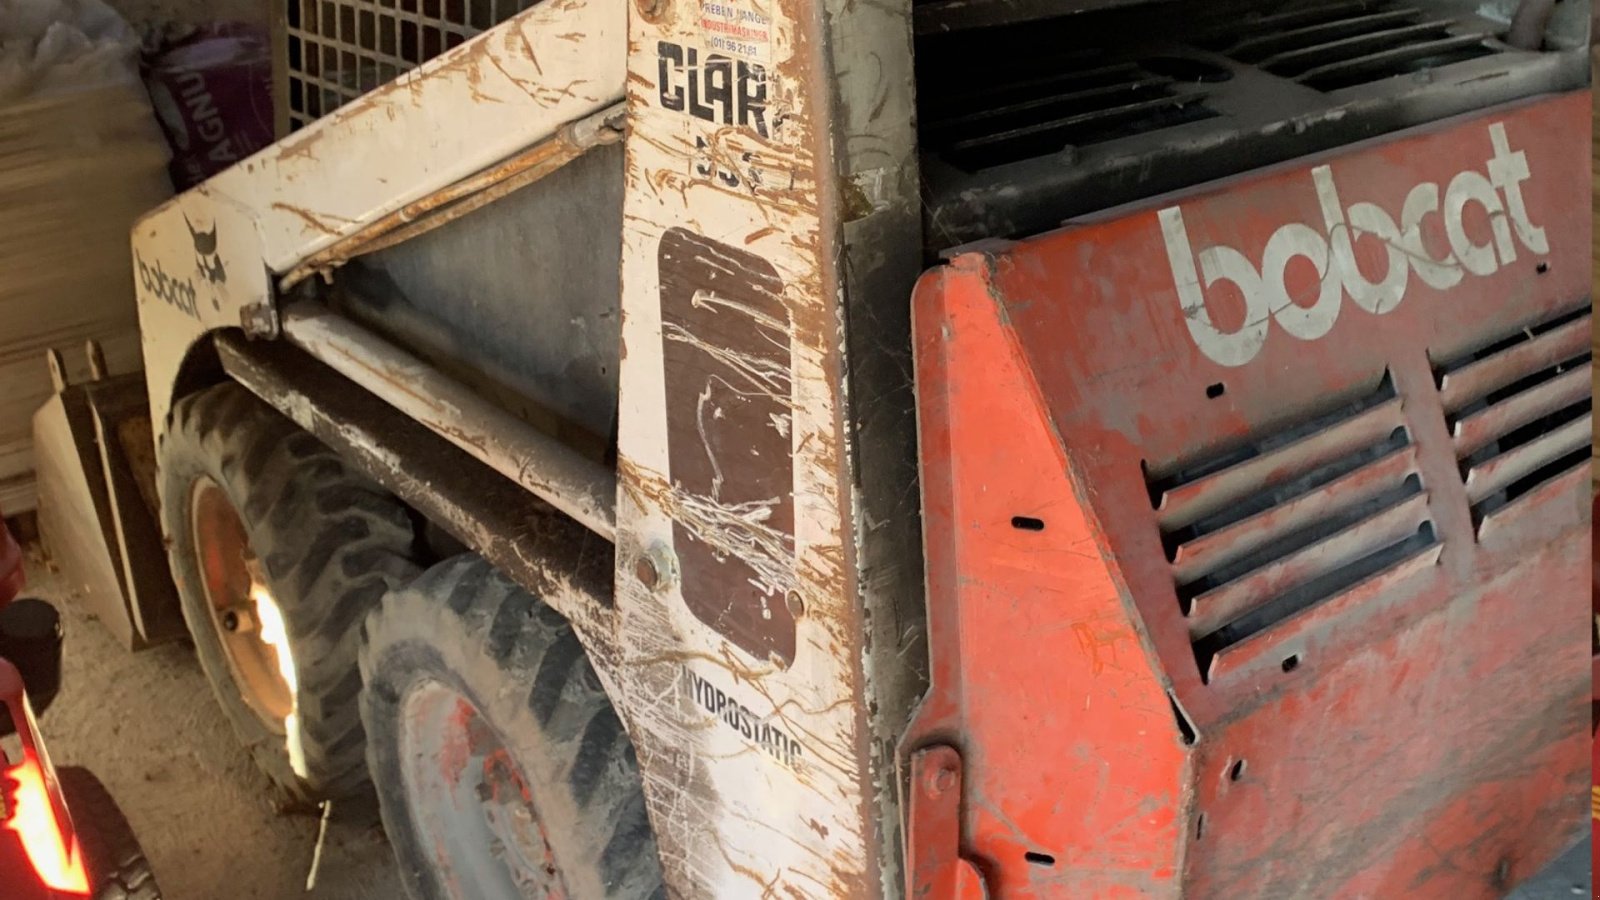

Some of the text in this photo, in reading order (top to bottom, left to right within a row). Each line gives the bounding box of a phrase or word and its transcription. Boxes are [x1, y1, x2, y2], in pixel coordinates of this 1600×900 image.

[703, 2, 733, 18] REBEN
[726, 40, 737, 52] 96
[174, 71, 238, 161] AGNU
[657, 40, 779, 141] CLAR
[135, 247, 201, 322] bobcat
[1157, 121, 1550, 367] bobcat
[682, 664, 803, 771] HYDROSTATIC
